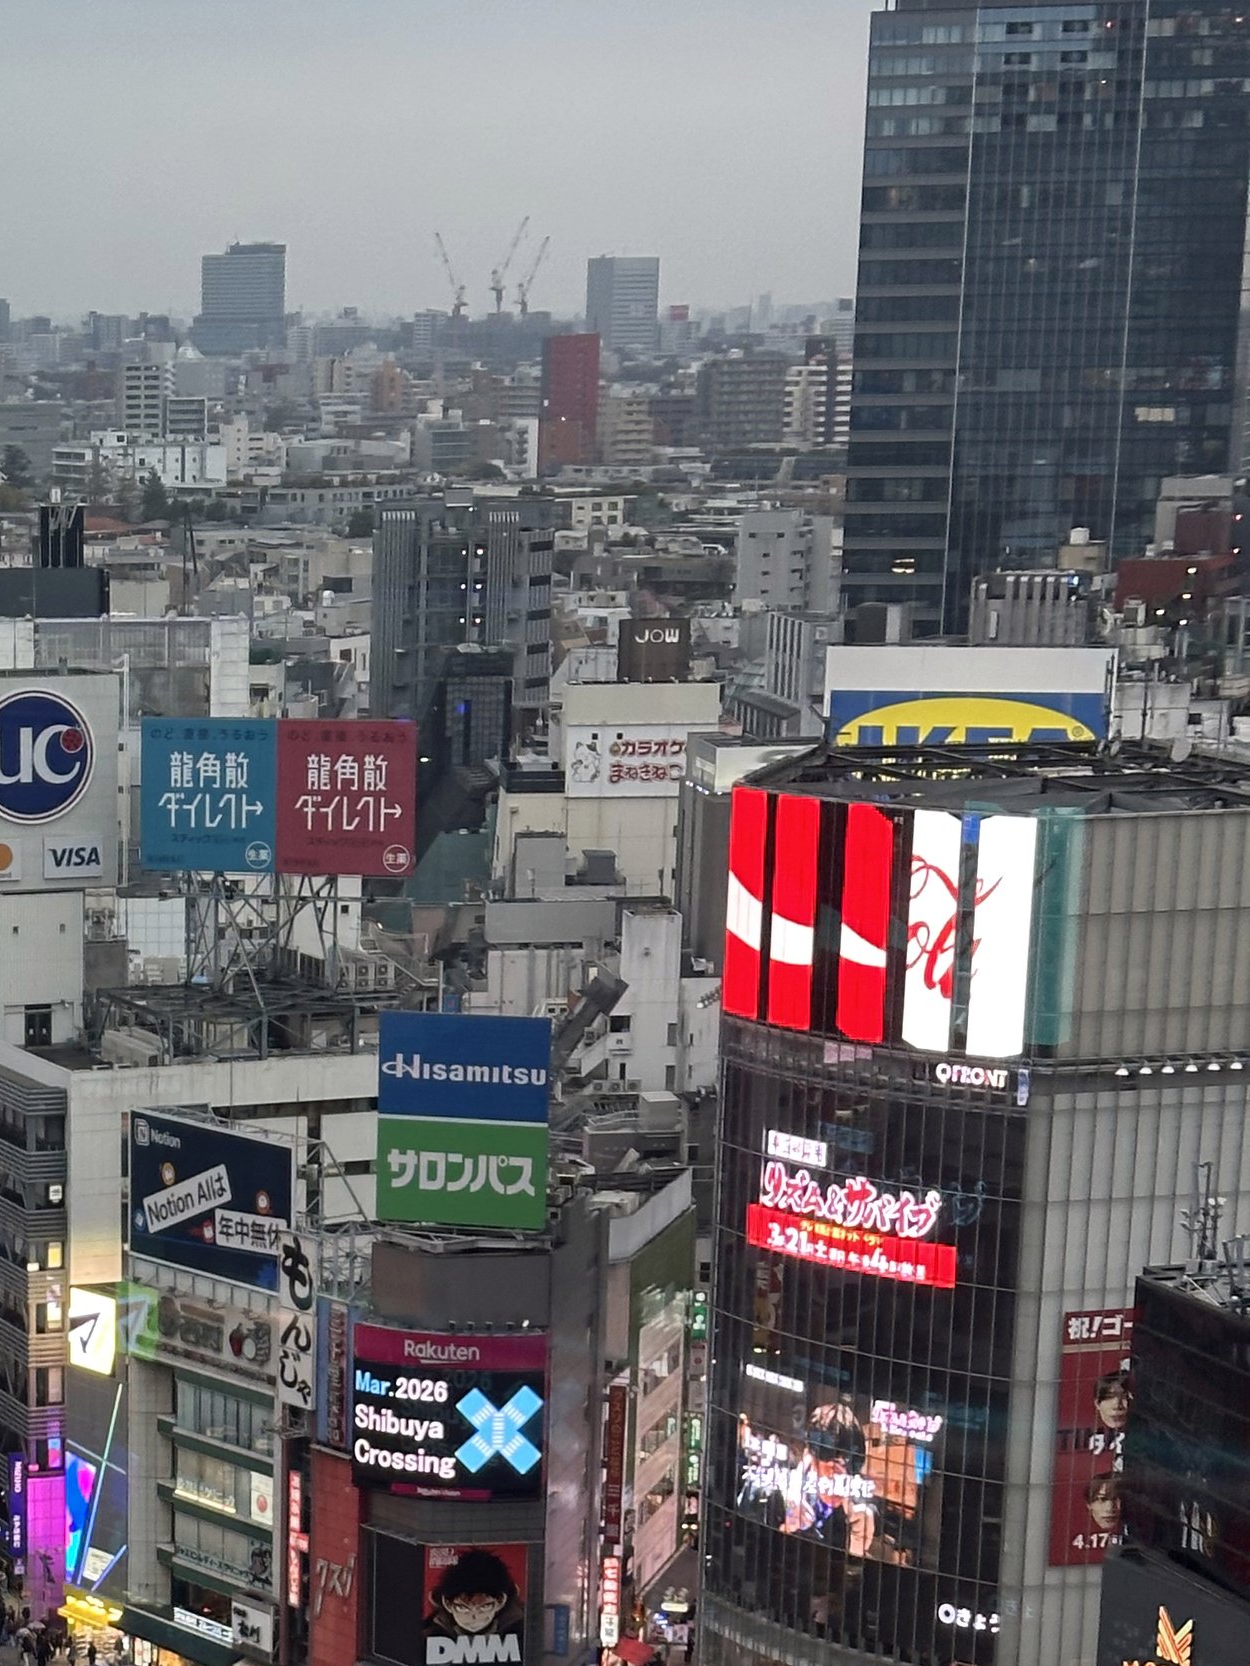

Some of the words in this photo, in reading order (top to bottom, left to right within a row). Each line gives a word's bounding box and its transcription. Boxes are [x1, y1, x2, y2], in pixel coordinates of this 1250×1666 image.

[634, 628, 680, 643] JOW
[621, 739, 686, 757] カラオケ
[170, 752, 249, 789] 龍角散
[307, 753, 388, 791] 龍角散
[609, 762, 683, 784] まねきねこ
[158, 792, 264, 829] ダイレクト
[294, 795, 402, 832] ダイレクト
[49, 847, 101, 868] VISA
[382, 1053, 547, 1087] Hisamitsu
[150, 1128, 181, 1149] Notion
[387, 1149, 535, 1197] サロンパス
[147, 1193, 194, 1226] Notion
[218, 1213, 281, 1249] 年中無休
[280, 1236, 313, 1406] もんじゃ
[404, 1339, 480, 1361] Rakuten
[355, 1404, 445, 1441] Shibuya
[354, 1438, 457, 1479] Crossing
[1073, 1533, 1109, 1550] 4.17
[316, 1552, 357, 1617] クスリ
[426, 1634, 521, 1665] DMM
